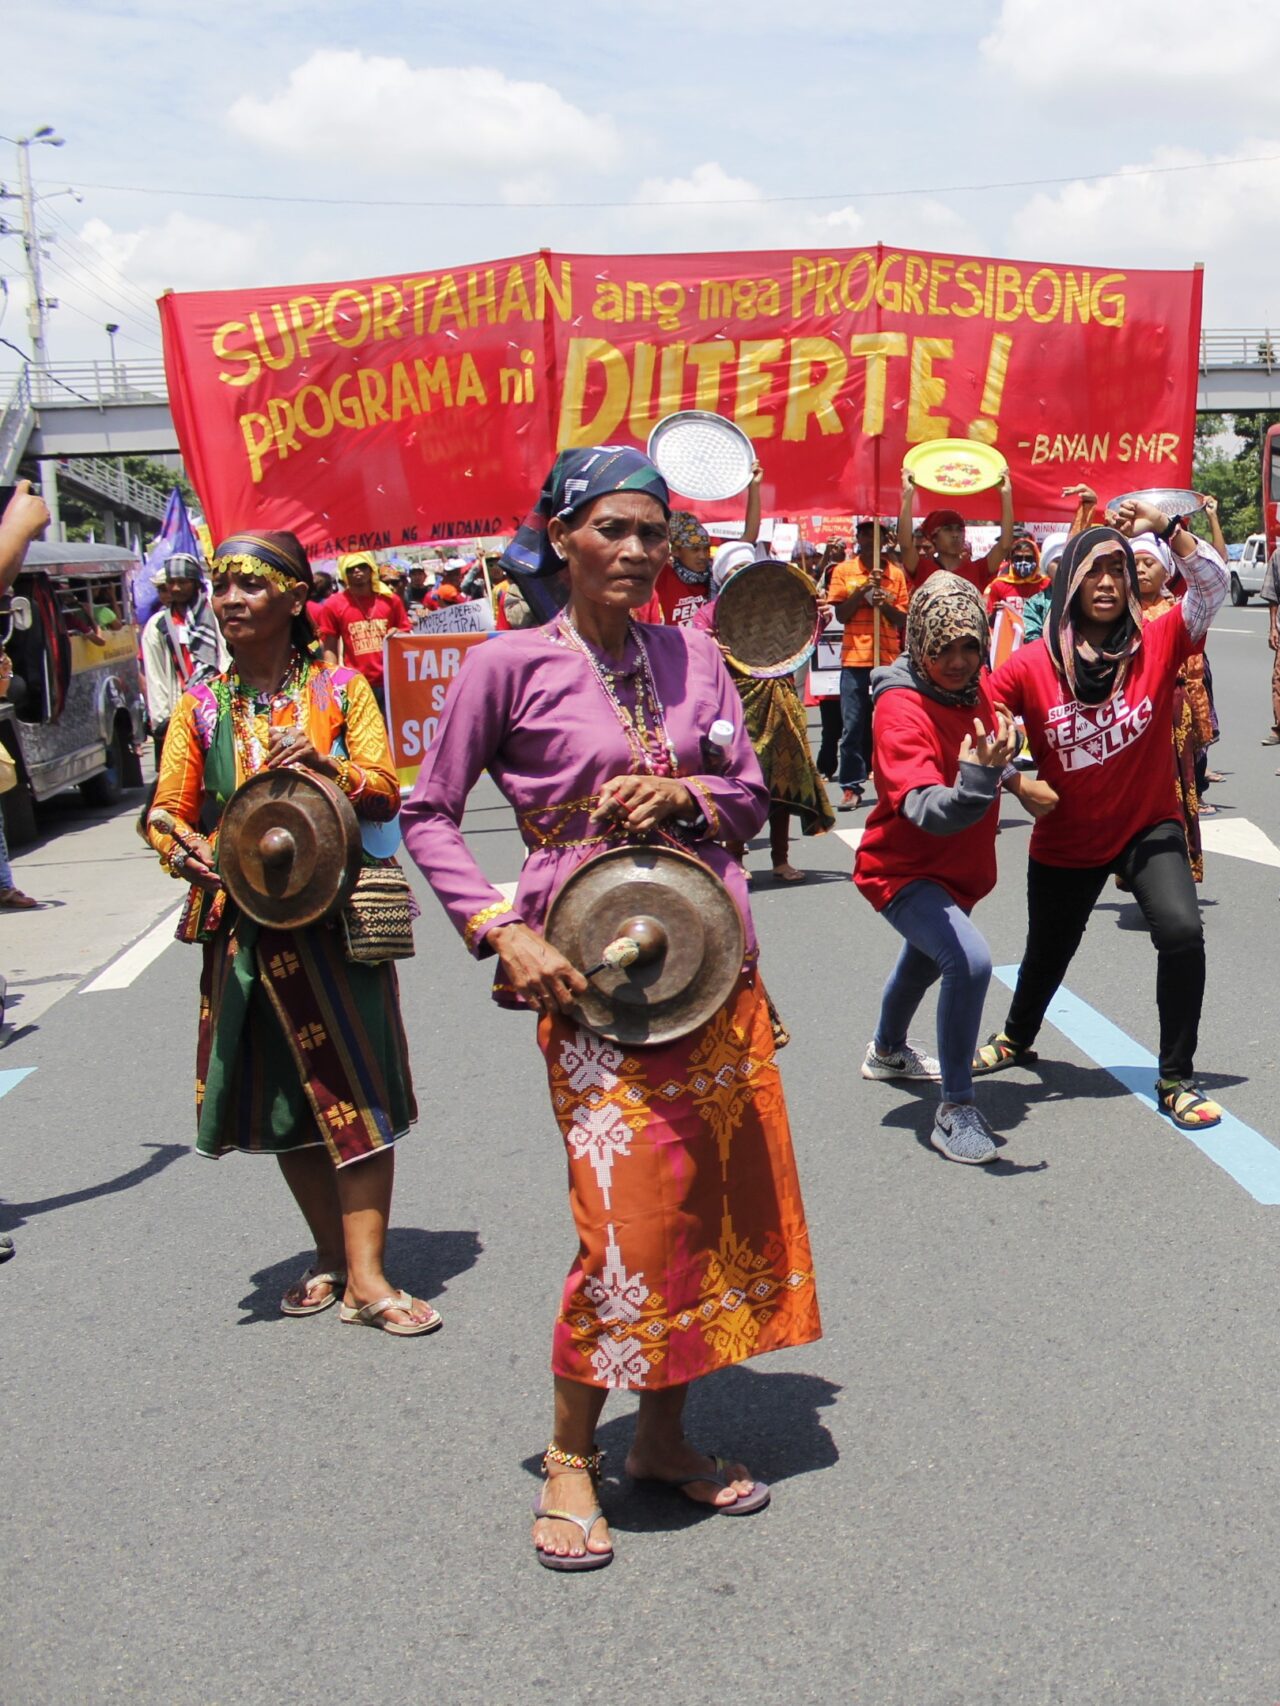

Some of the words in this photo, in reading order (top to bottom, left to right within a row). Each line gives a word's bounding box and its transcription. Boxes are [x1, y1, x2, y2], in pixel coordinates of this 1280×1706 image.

[212, 257, 573, 387] SUPORTAHAN
[591, 280, 686, 331] ang
[699, 277, 780, 321] mga
[791, 252, 1127, 328] PROGRESIBONG
[239, 352, 488, 484] PROGRAMA
[500, 349, 535, 405] ni
[1116, 432, 1180, 465] SMR
[401, 525, 417, 542] NG
